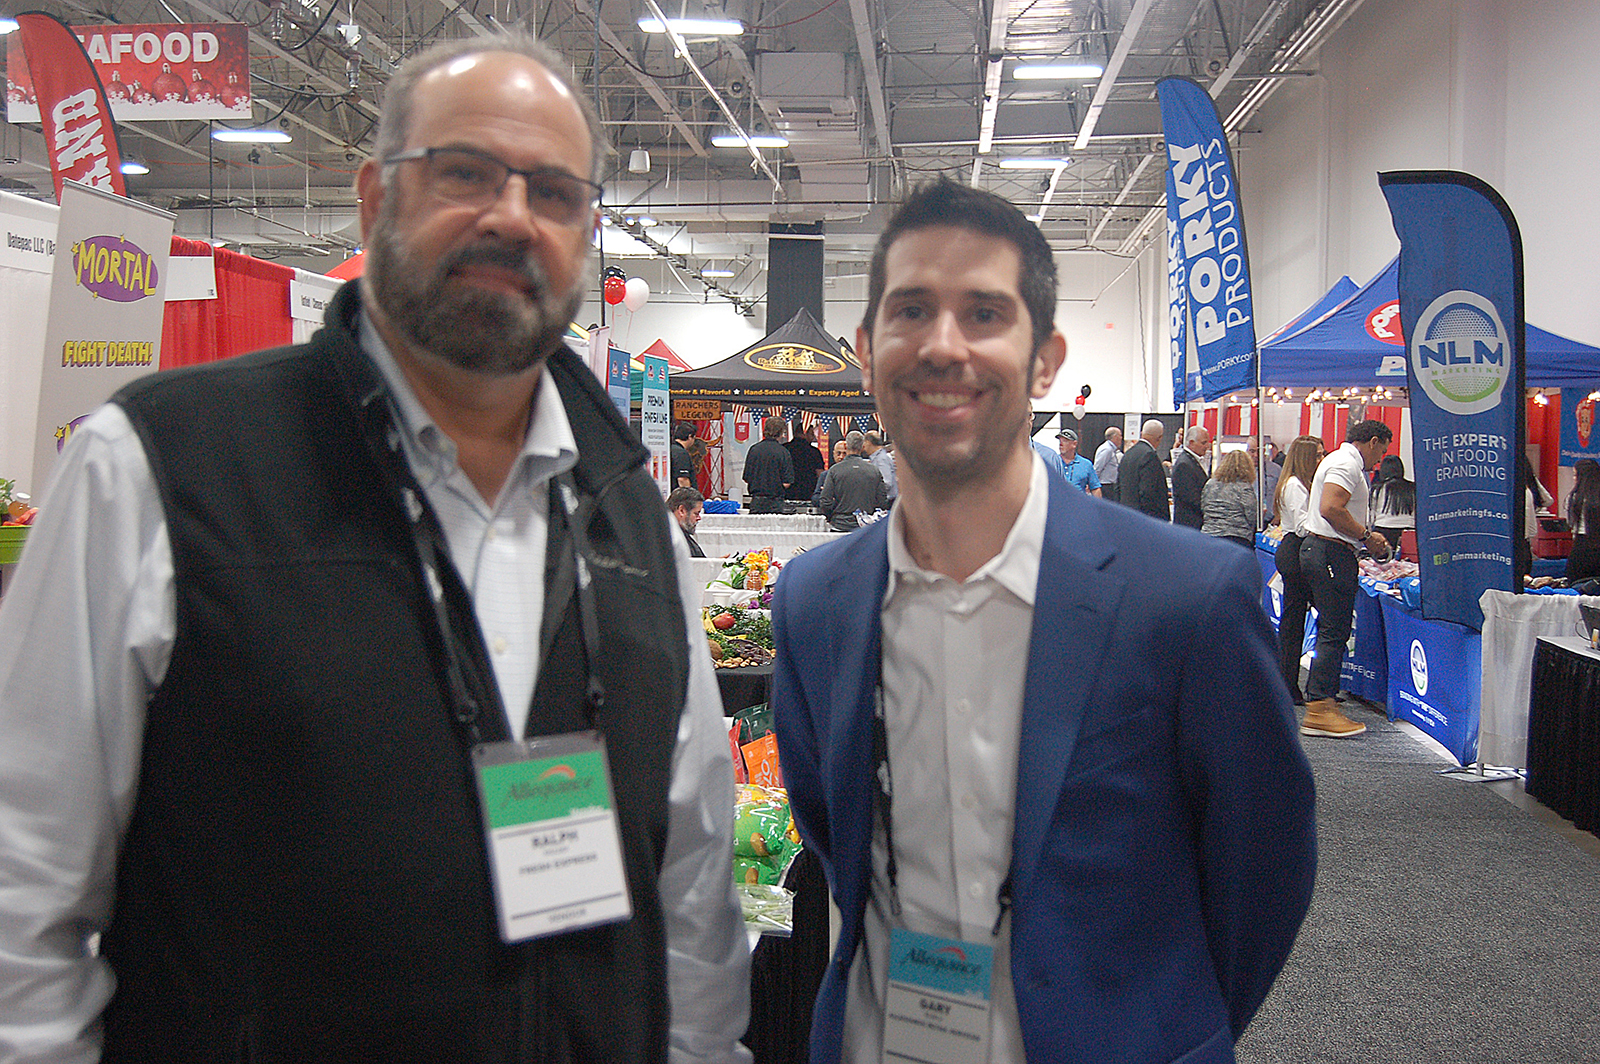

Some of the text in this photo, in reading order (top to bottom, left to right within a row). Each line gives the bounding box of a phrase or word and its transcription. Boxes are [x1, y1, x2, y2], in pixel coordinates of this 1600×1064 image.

[80, 32, 220, 64] AFOOD
[1200, 137, 1251, 328] PRODUCTS
[1168, 143, 1227, 346] PORKY
[76, 240, 156, 296] MORTAL
[62, 340, 154, 368] FIGHT DEATH!
[1418, 340, 1503, 369] NLM
[1431, 366, 1500, 376] MARKETING
[692, 388, 698, 396] &
[700, 388, 731, 396] Flavorful
[743, 388, 796, 397] Hand-Selected
[808, 389, 840, 398] Expertly
[840, 389, 860, 398] Aged
[675, 401, 719, 410] RANCHERS
[681, 411, 714, 419] LEGEND
[1423, 436, 1448, 451] THE
[1441, 448, 1499, 464] IN FOOD
[1436, 464, 1506, 481] BRANDING
